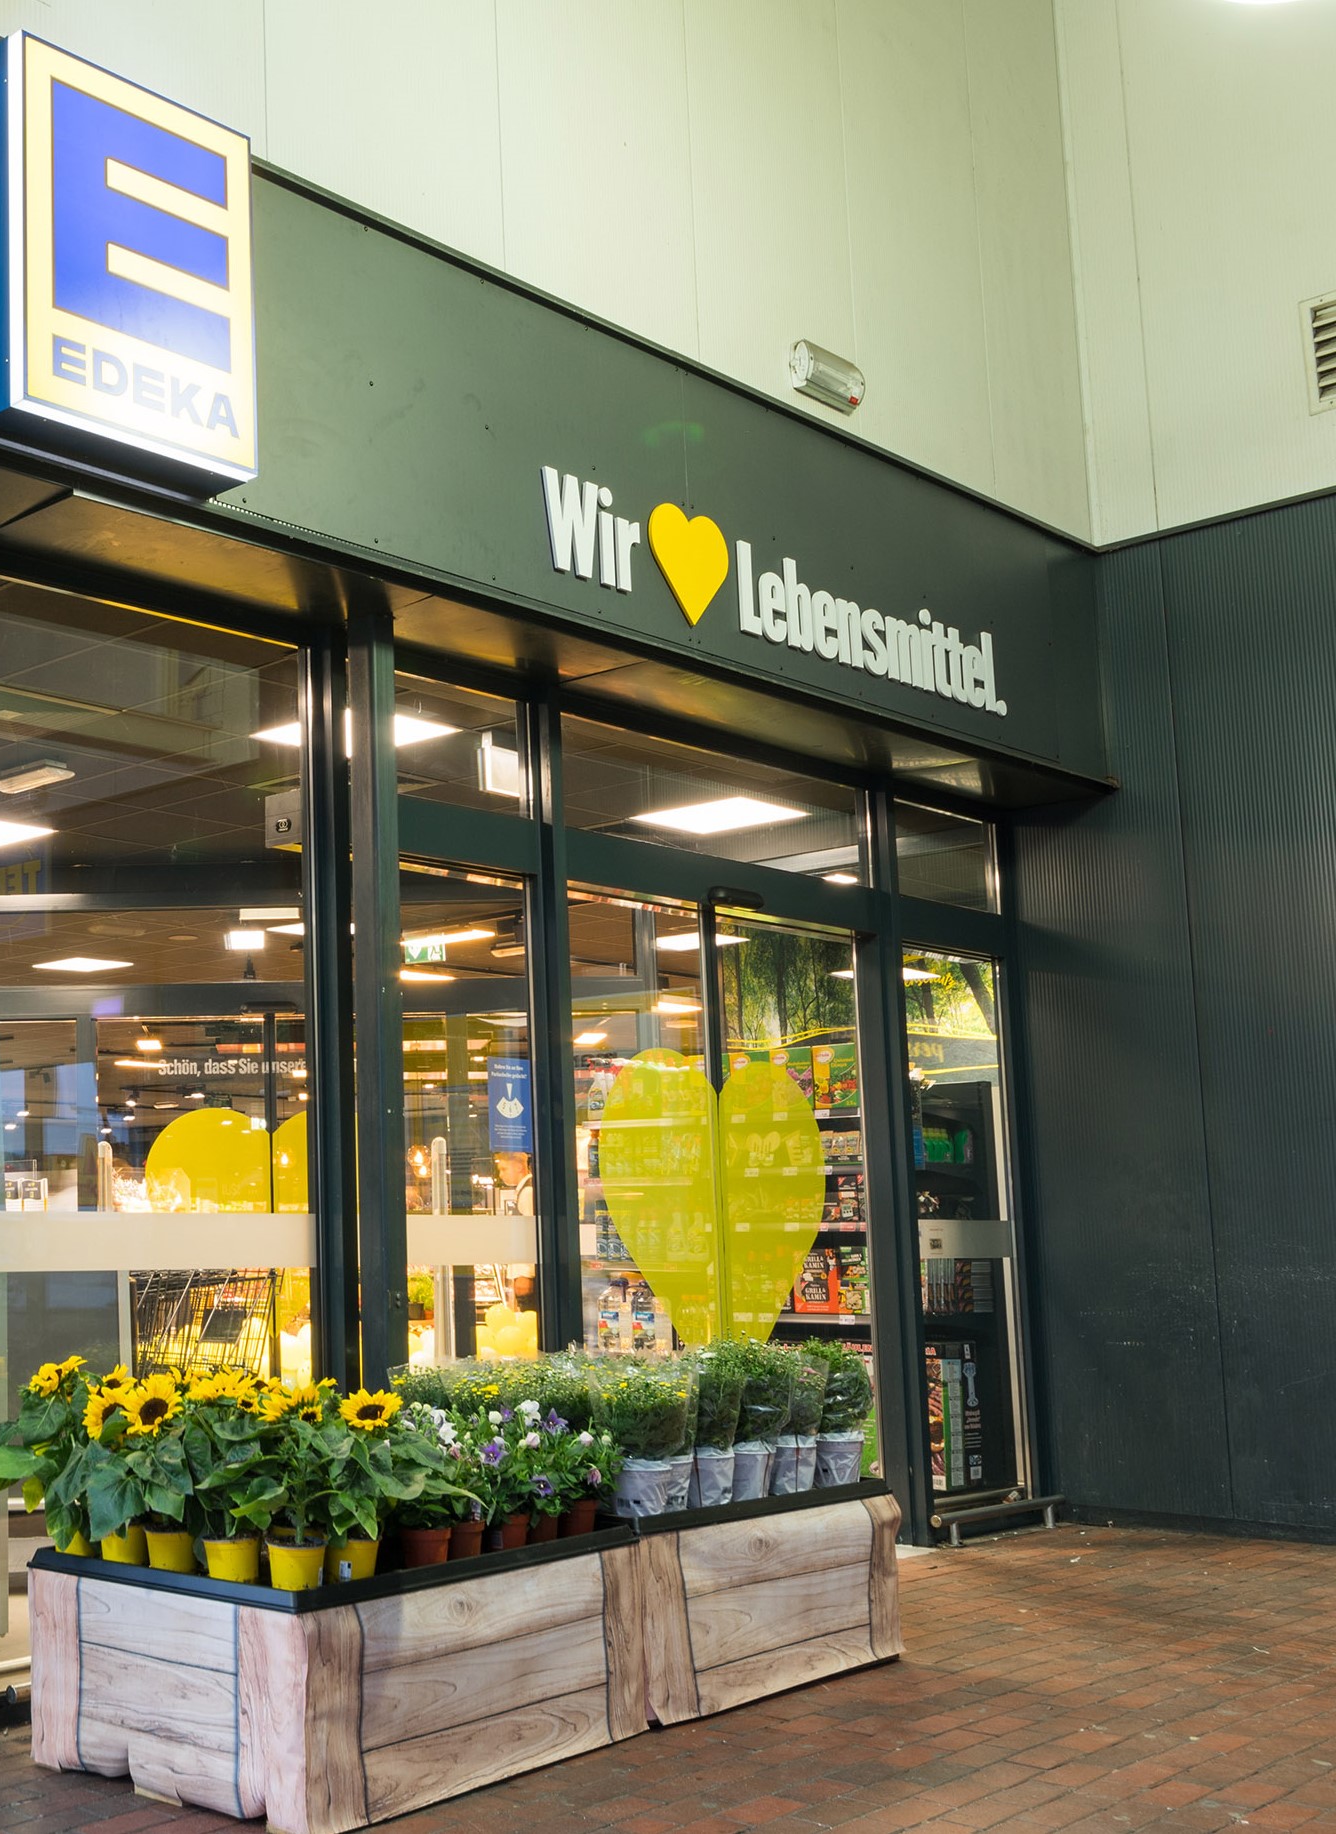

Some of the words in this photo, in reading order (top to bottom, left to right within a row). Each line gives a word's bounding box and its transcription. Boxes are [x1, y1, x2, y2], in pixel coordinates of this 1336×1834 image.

[52, 333, 240, 439] EDEKA
[541, 465, 640, 593] Wir
[736, 540, 1008, 717] Lebensmittel.
[158, 1058, 201, 1078] Schön,
[204, 1058, 236, 1075] dass
[238, 1058, 259, 1075] Sie
